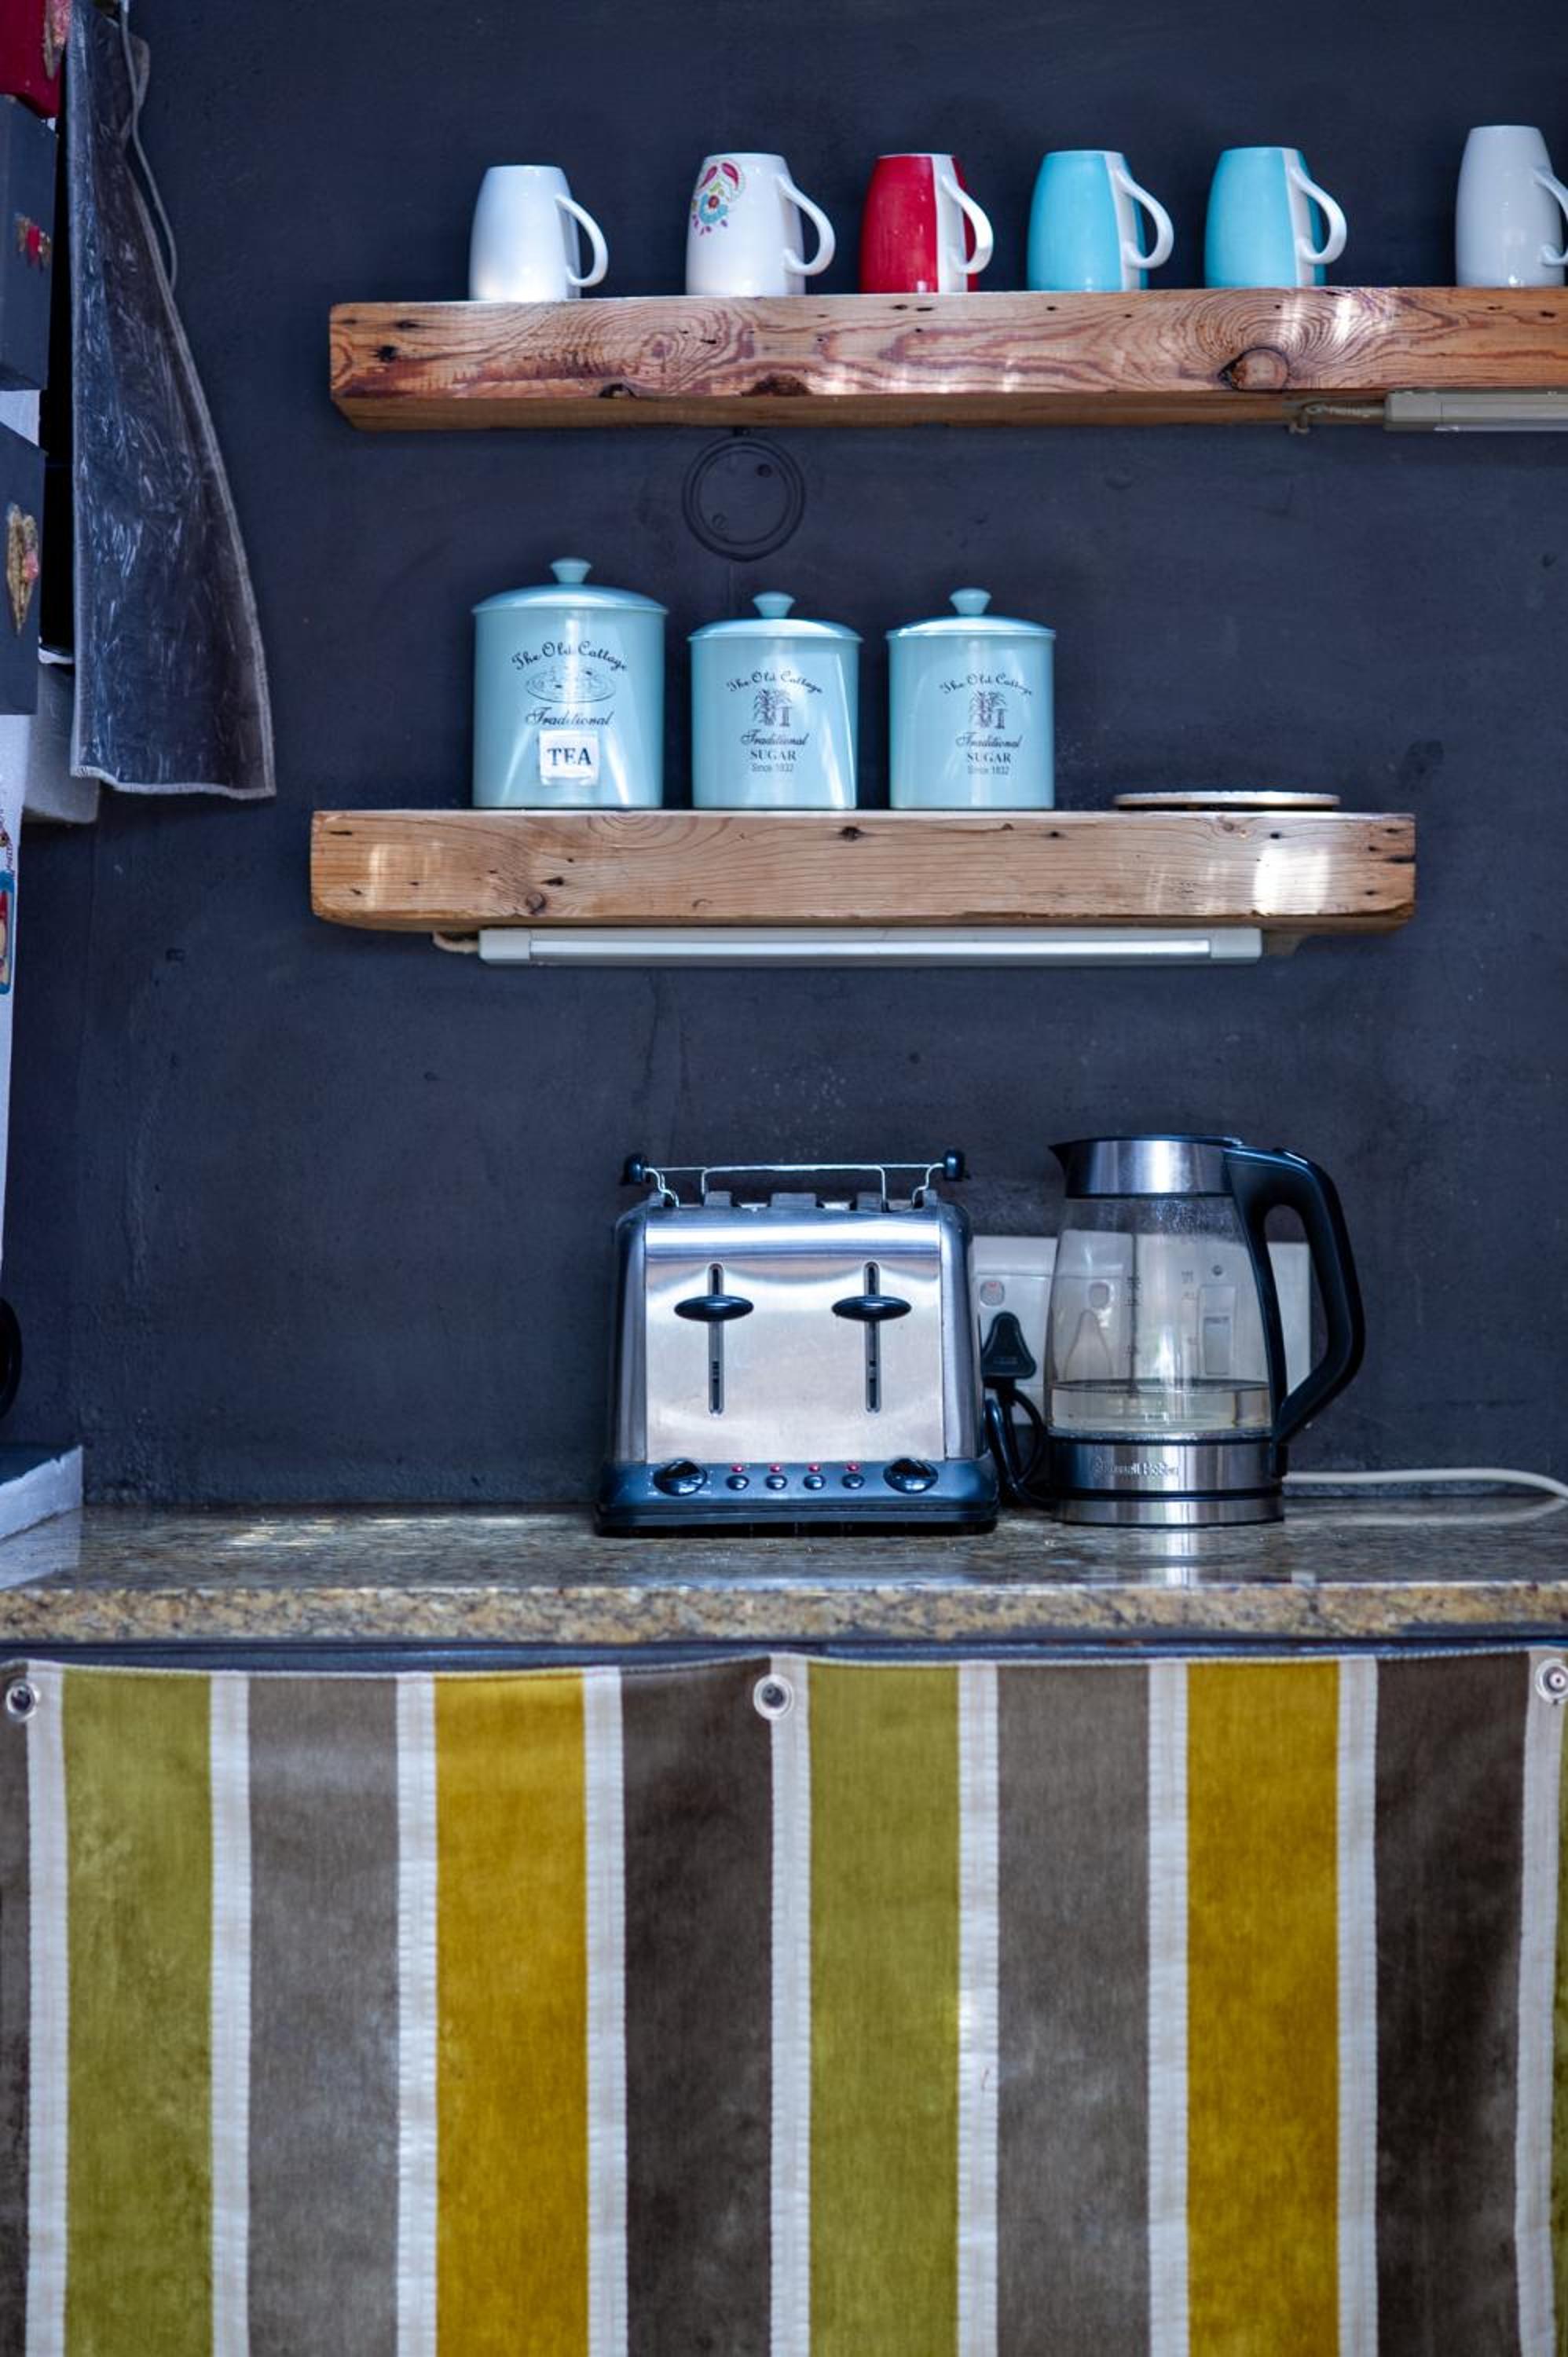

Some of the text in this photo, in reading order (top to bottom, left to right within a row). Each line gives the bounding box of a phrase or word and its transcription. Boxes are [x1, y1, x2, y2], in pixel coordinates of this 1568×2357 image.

[511, 651, 541, 670] The
[727, 679, 752, 692] The
[752, 671, 775, 684] Old
[940, 680, 965, 694] The
[967, 673, 992, 685] Old
[526, 706, 614, 725] Traditional
[741, 729, 809, 746] Traditional
[956, 731, 1023, 748] Traditional
[547, 747, 592, 766] TEA
[750, 750, 797, 761] SUGAR
[967, 752, 1011, 764] SUGAR
